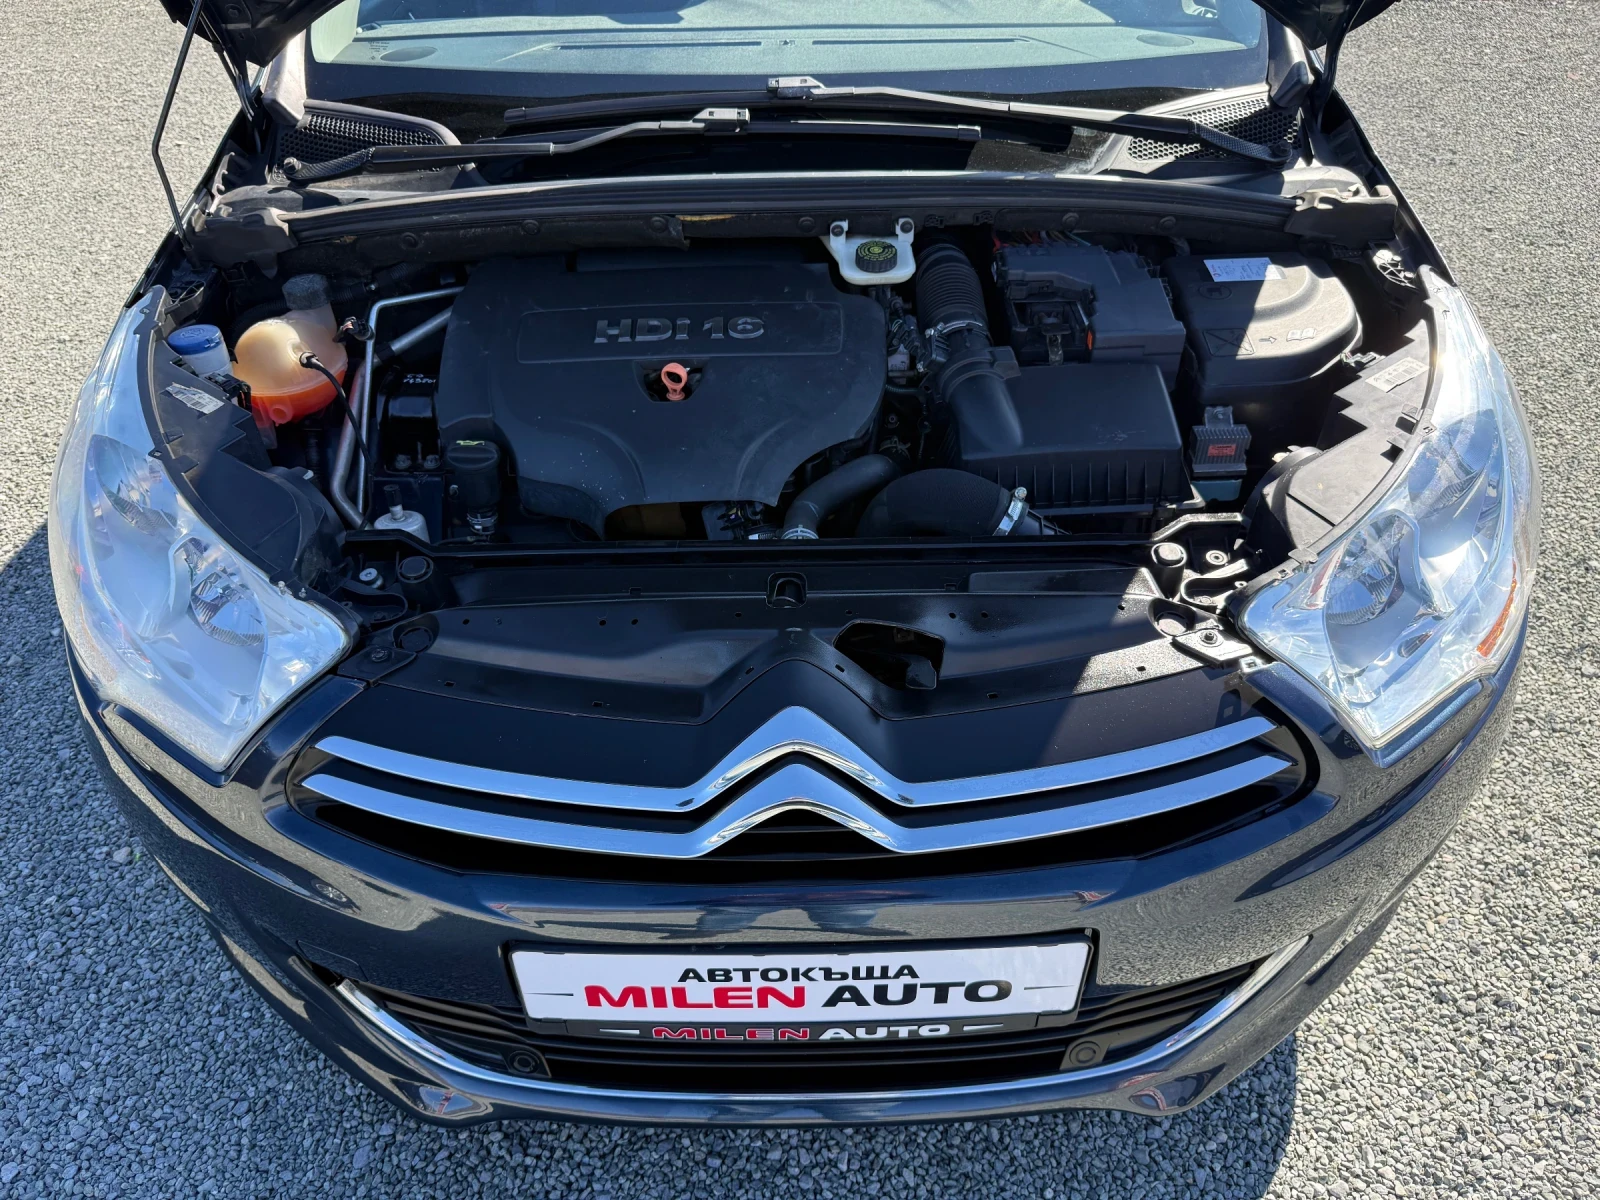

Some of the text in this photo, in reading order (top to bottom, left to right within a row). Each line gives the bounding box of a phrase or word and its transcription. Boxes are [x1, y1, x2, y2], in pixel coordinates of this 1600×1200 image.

[594, 316, 765, 343] HDi 16
[584, 979, 1013, 1009] MILEN AUTO
[652, 1024, 950, 1040] MILEN AUTO
